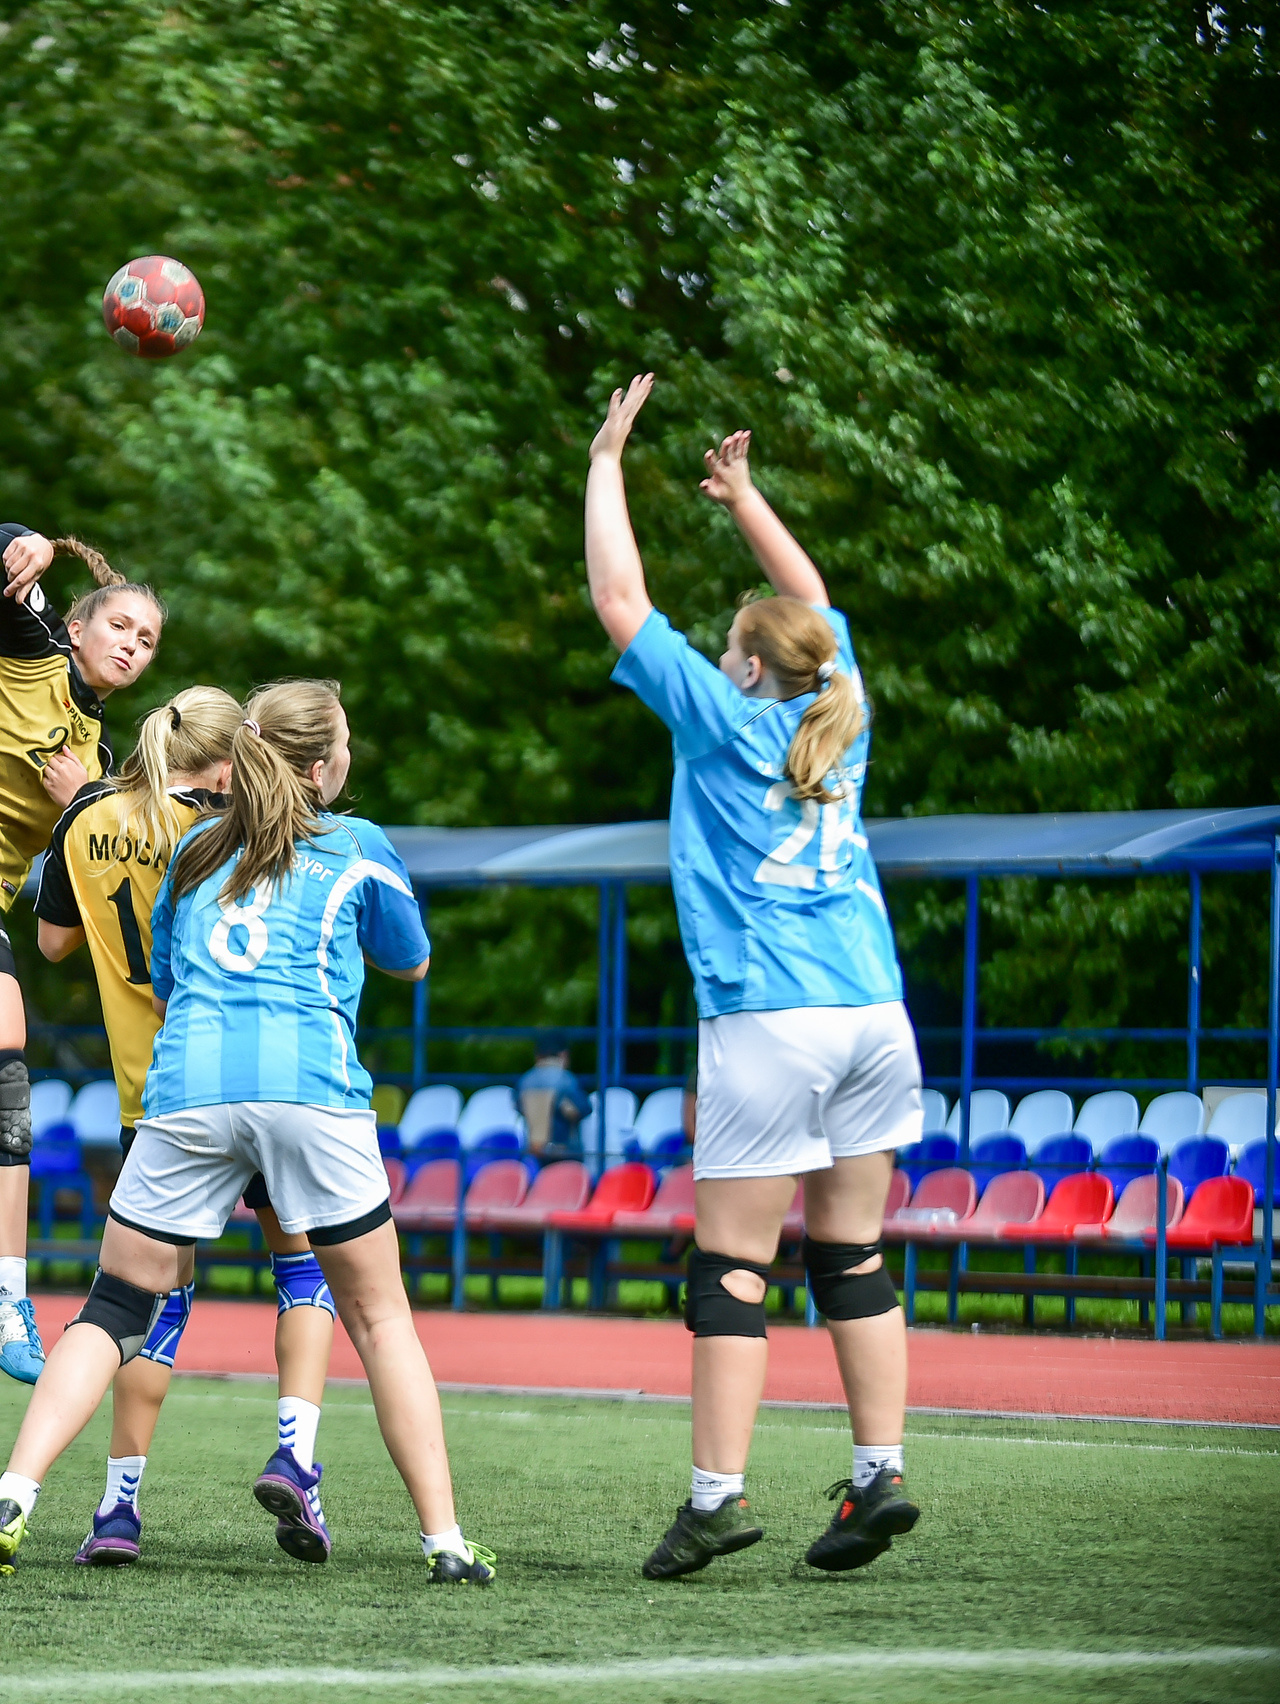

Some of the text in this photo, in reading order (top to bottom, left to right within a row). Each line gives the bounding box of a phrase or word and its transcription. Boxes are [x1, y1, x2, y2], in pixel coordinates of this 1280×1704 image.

[67, 707, 91, 741] PATRICK
[107, 877, 151, 984] 1
[209, 871, 273, 972] 8
